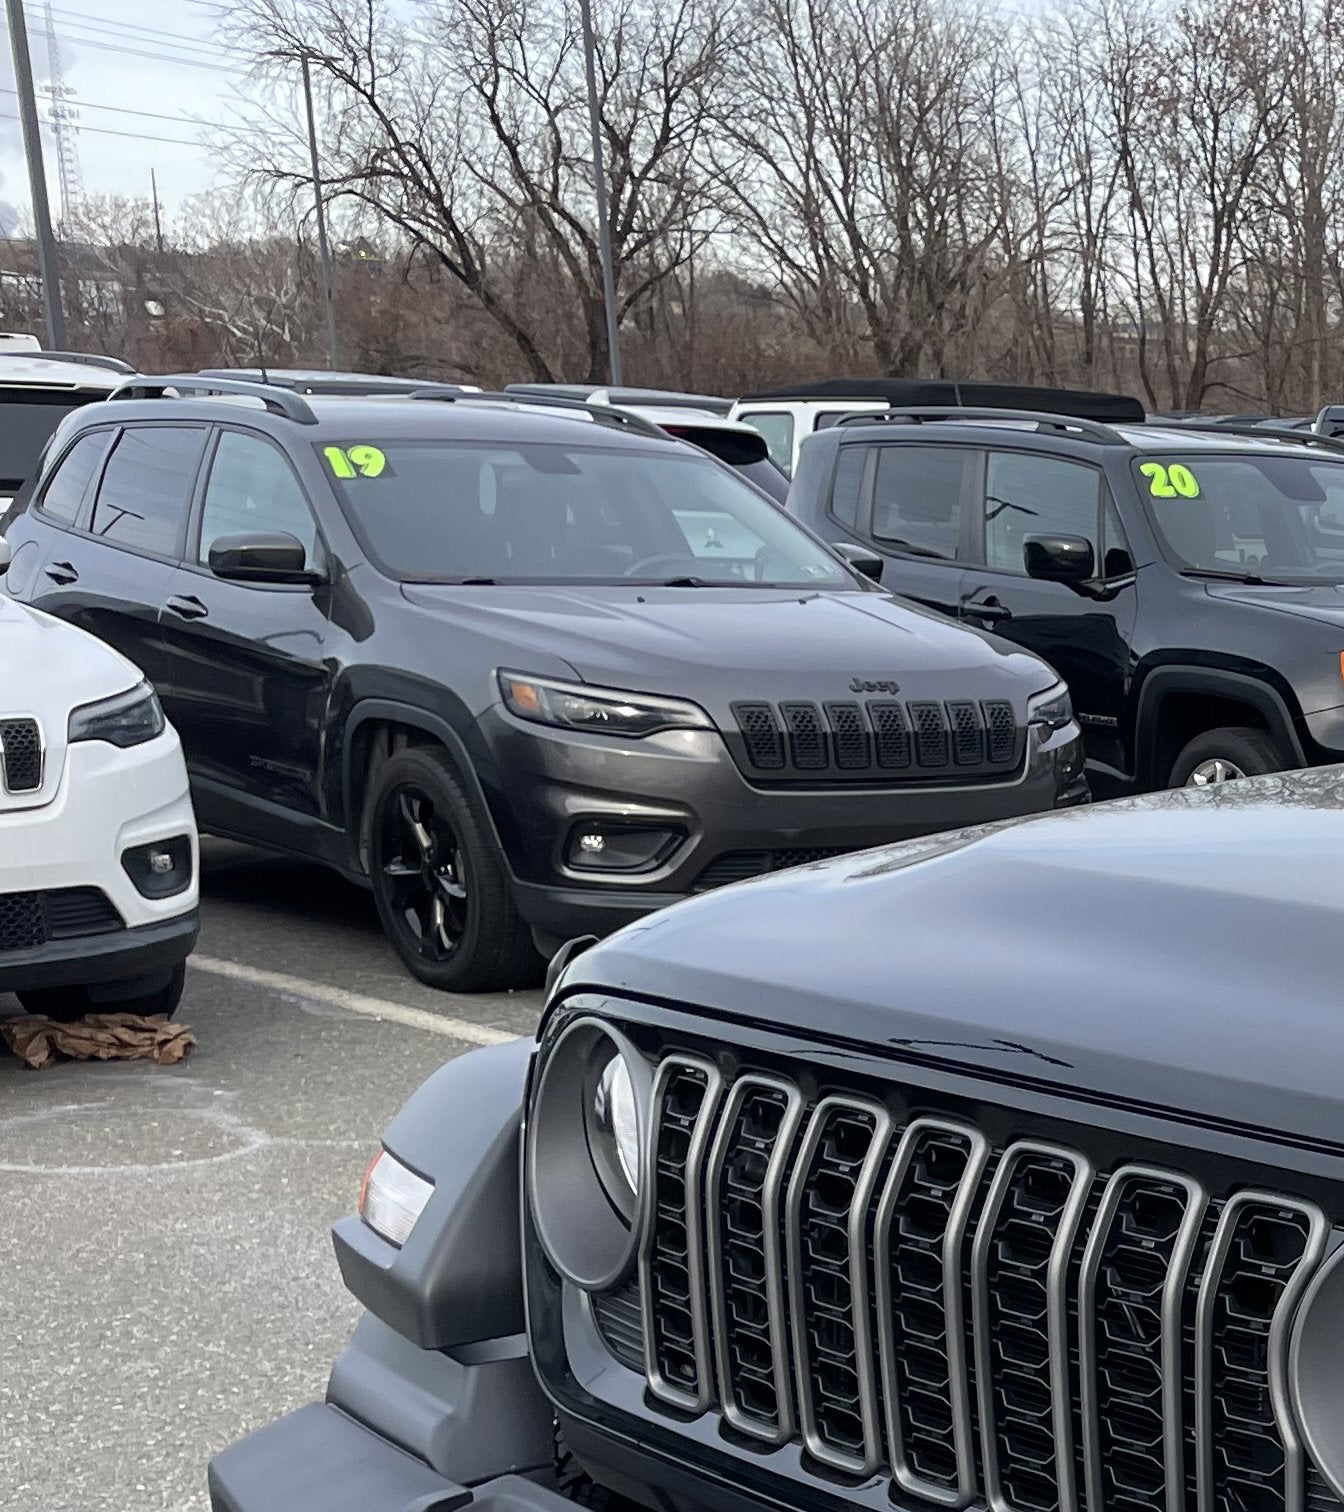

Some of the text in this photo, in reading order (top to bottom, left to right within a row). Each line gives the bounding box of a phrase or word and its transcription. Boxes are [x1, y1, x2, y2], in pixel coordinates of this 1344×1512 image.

[324, 444, 386, 478] 19
[1140, 462, 1200, 498] 20
[849, 678, 900, 696] Jeep
